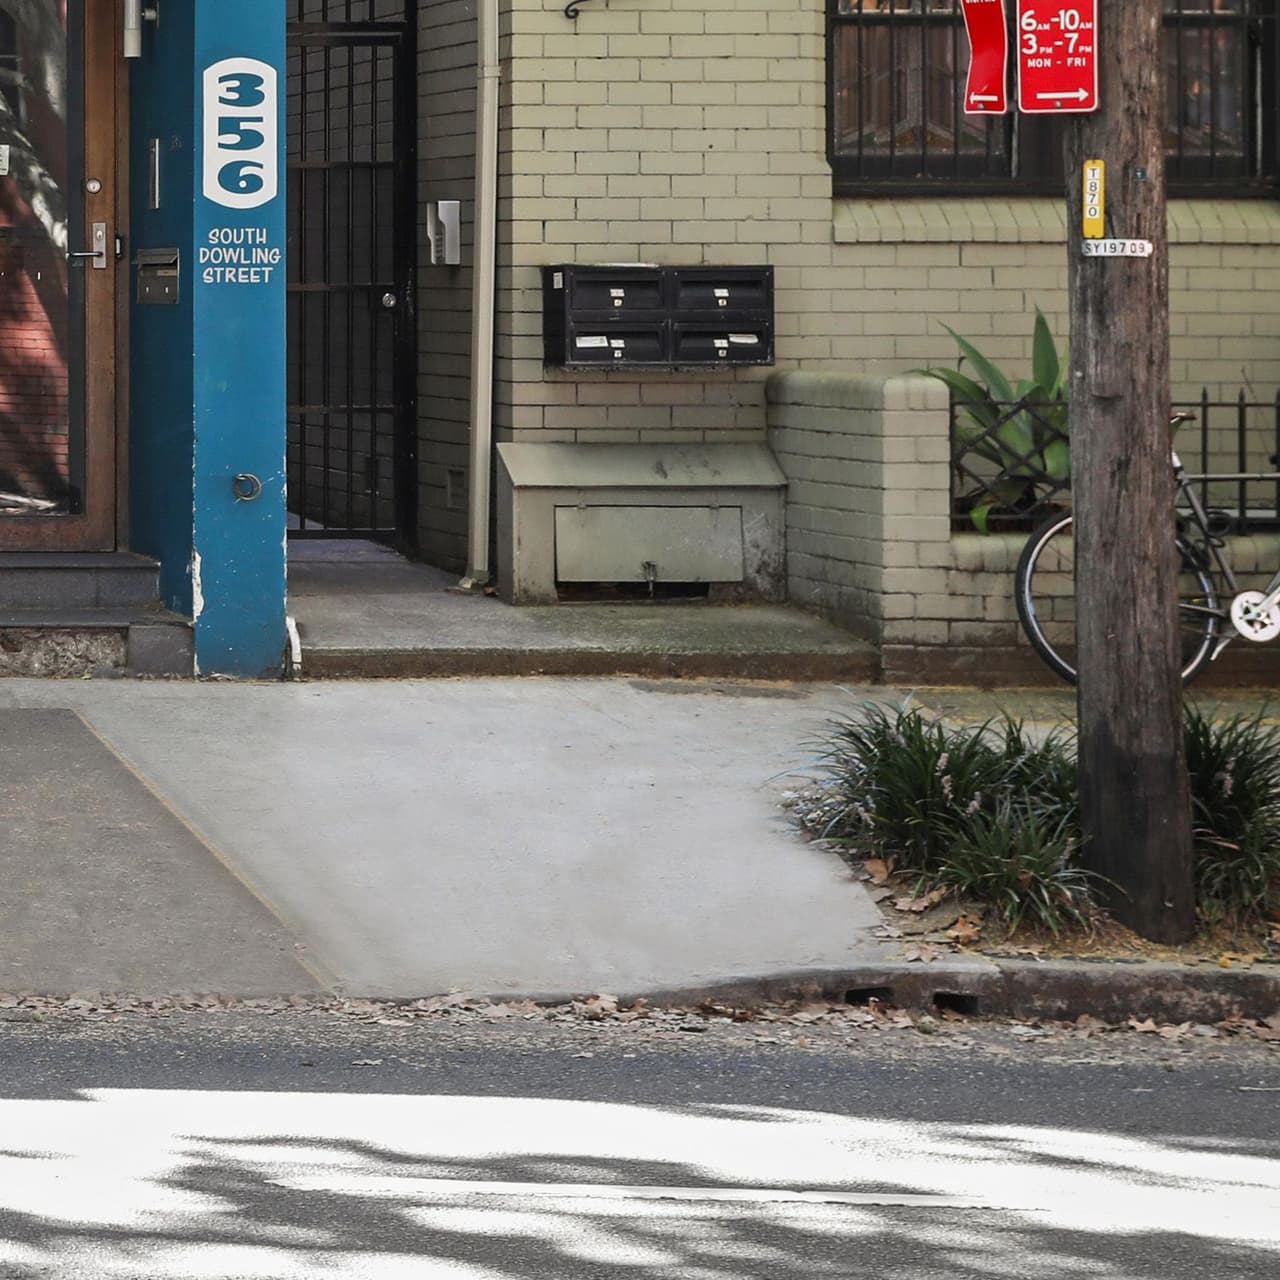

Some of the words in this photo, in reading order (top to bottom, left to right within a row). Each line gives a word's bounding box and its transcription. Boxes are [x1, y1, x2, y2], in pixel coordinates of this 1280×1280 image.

[1027, 58, 1051, 68] MON
[1067, 57, 1086, 66] FRI
[217, 72, 265, 195] 356
[208, 228, 267, 245] SOUTH
[199, 247, 281, 265] DOWLING
[202, 267, 274, 284] STREET
